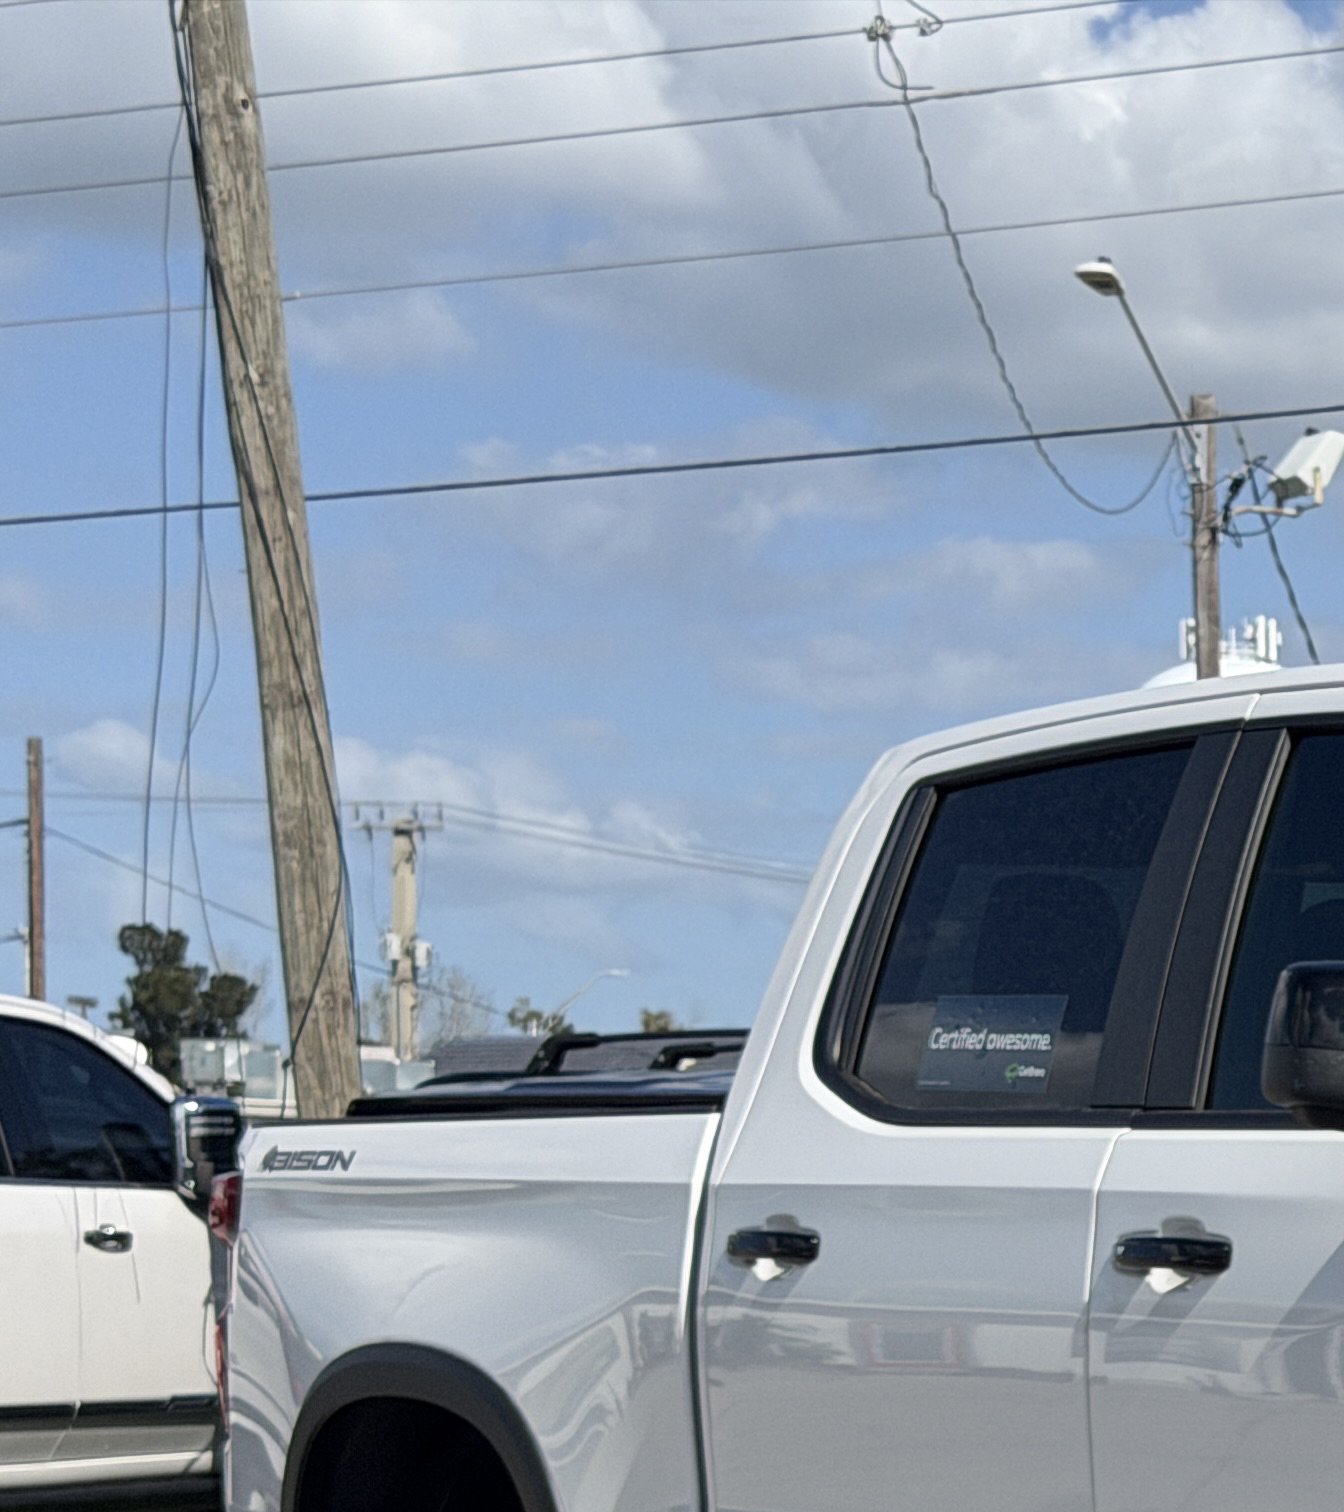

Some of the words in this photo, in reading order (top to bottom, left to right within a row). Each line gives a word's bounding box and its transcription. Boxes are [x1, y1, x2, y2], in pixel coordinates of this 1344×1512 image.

[930, 1027, 988, 1050] Certified
[986, 1032, 1052, 1051] awesome.
[264, 1147, 357, 1172] BISON
